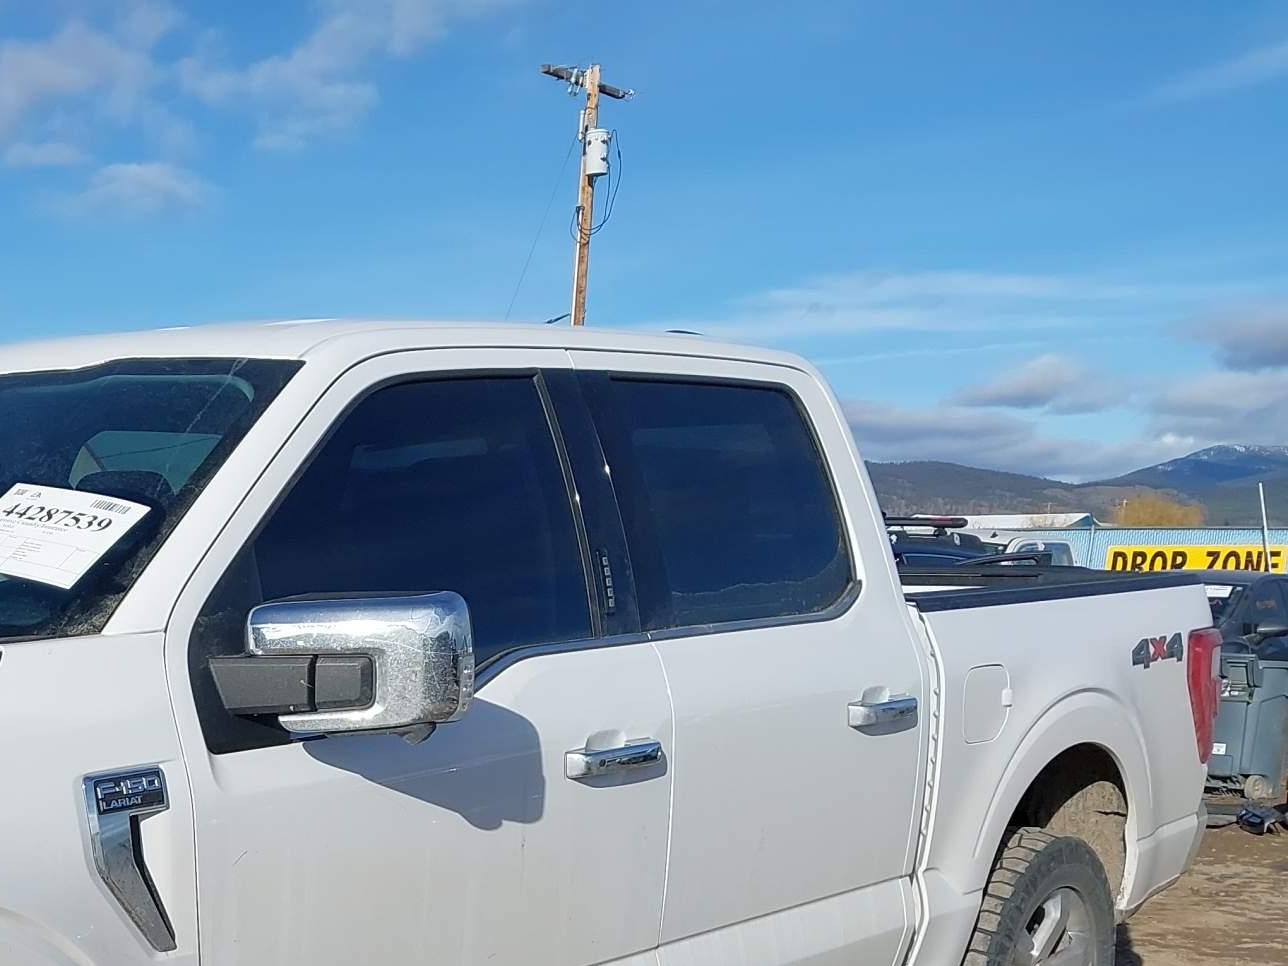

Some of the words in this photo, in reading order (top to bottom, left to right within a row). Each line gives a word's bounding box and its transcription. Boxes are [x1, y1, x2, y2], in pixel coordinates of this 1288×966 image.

[2, 503, 112, 532] 44287539
[1111, 550, 1188, 571] DROP
[1205, 550, 1282, 572] ZONE
[96, 775, 161, 799] F-150
[103, 795, 143, 809] LARIAT
